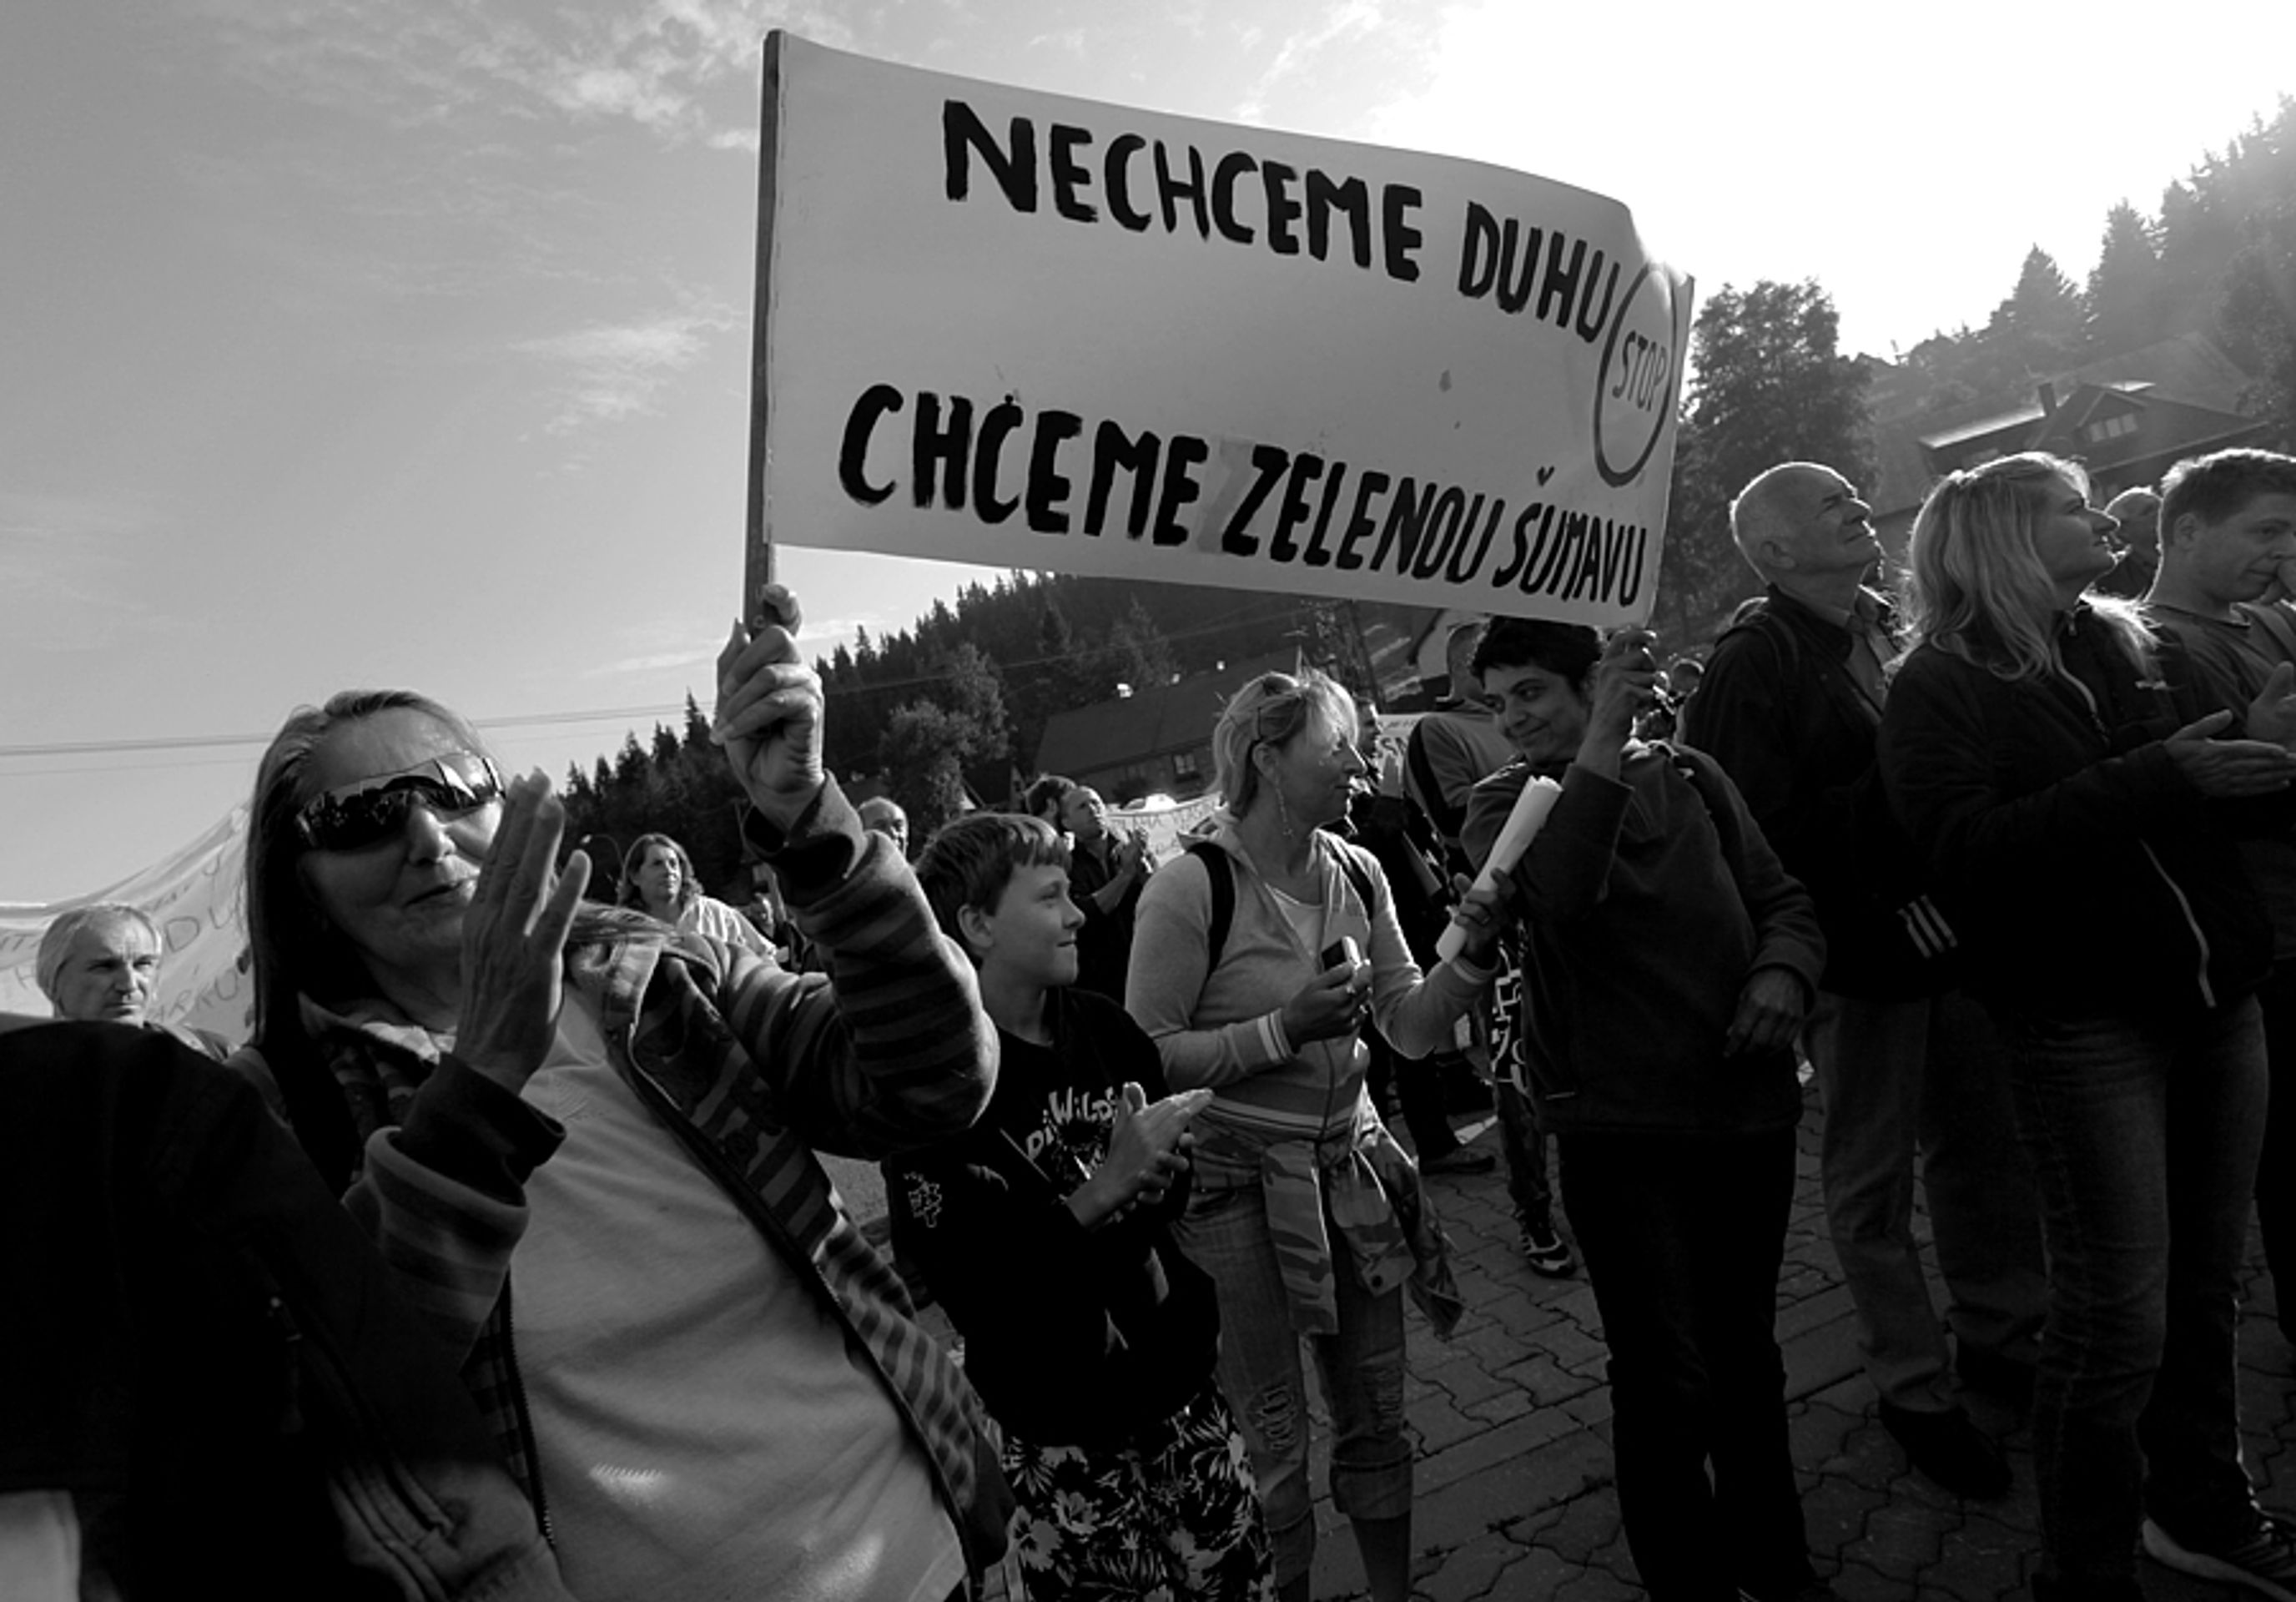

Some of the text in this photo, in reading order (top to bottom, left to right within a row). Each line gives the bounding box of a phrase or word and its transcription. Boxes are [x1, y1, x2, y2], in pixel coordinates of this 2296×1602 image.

[942, 98, 1621, 344] NECHCEME DUHU
[1612, 330, 1667, 412] STOP
[838, 383, 1647, 607] CHCEME ZELENOU ŠUMAVU
